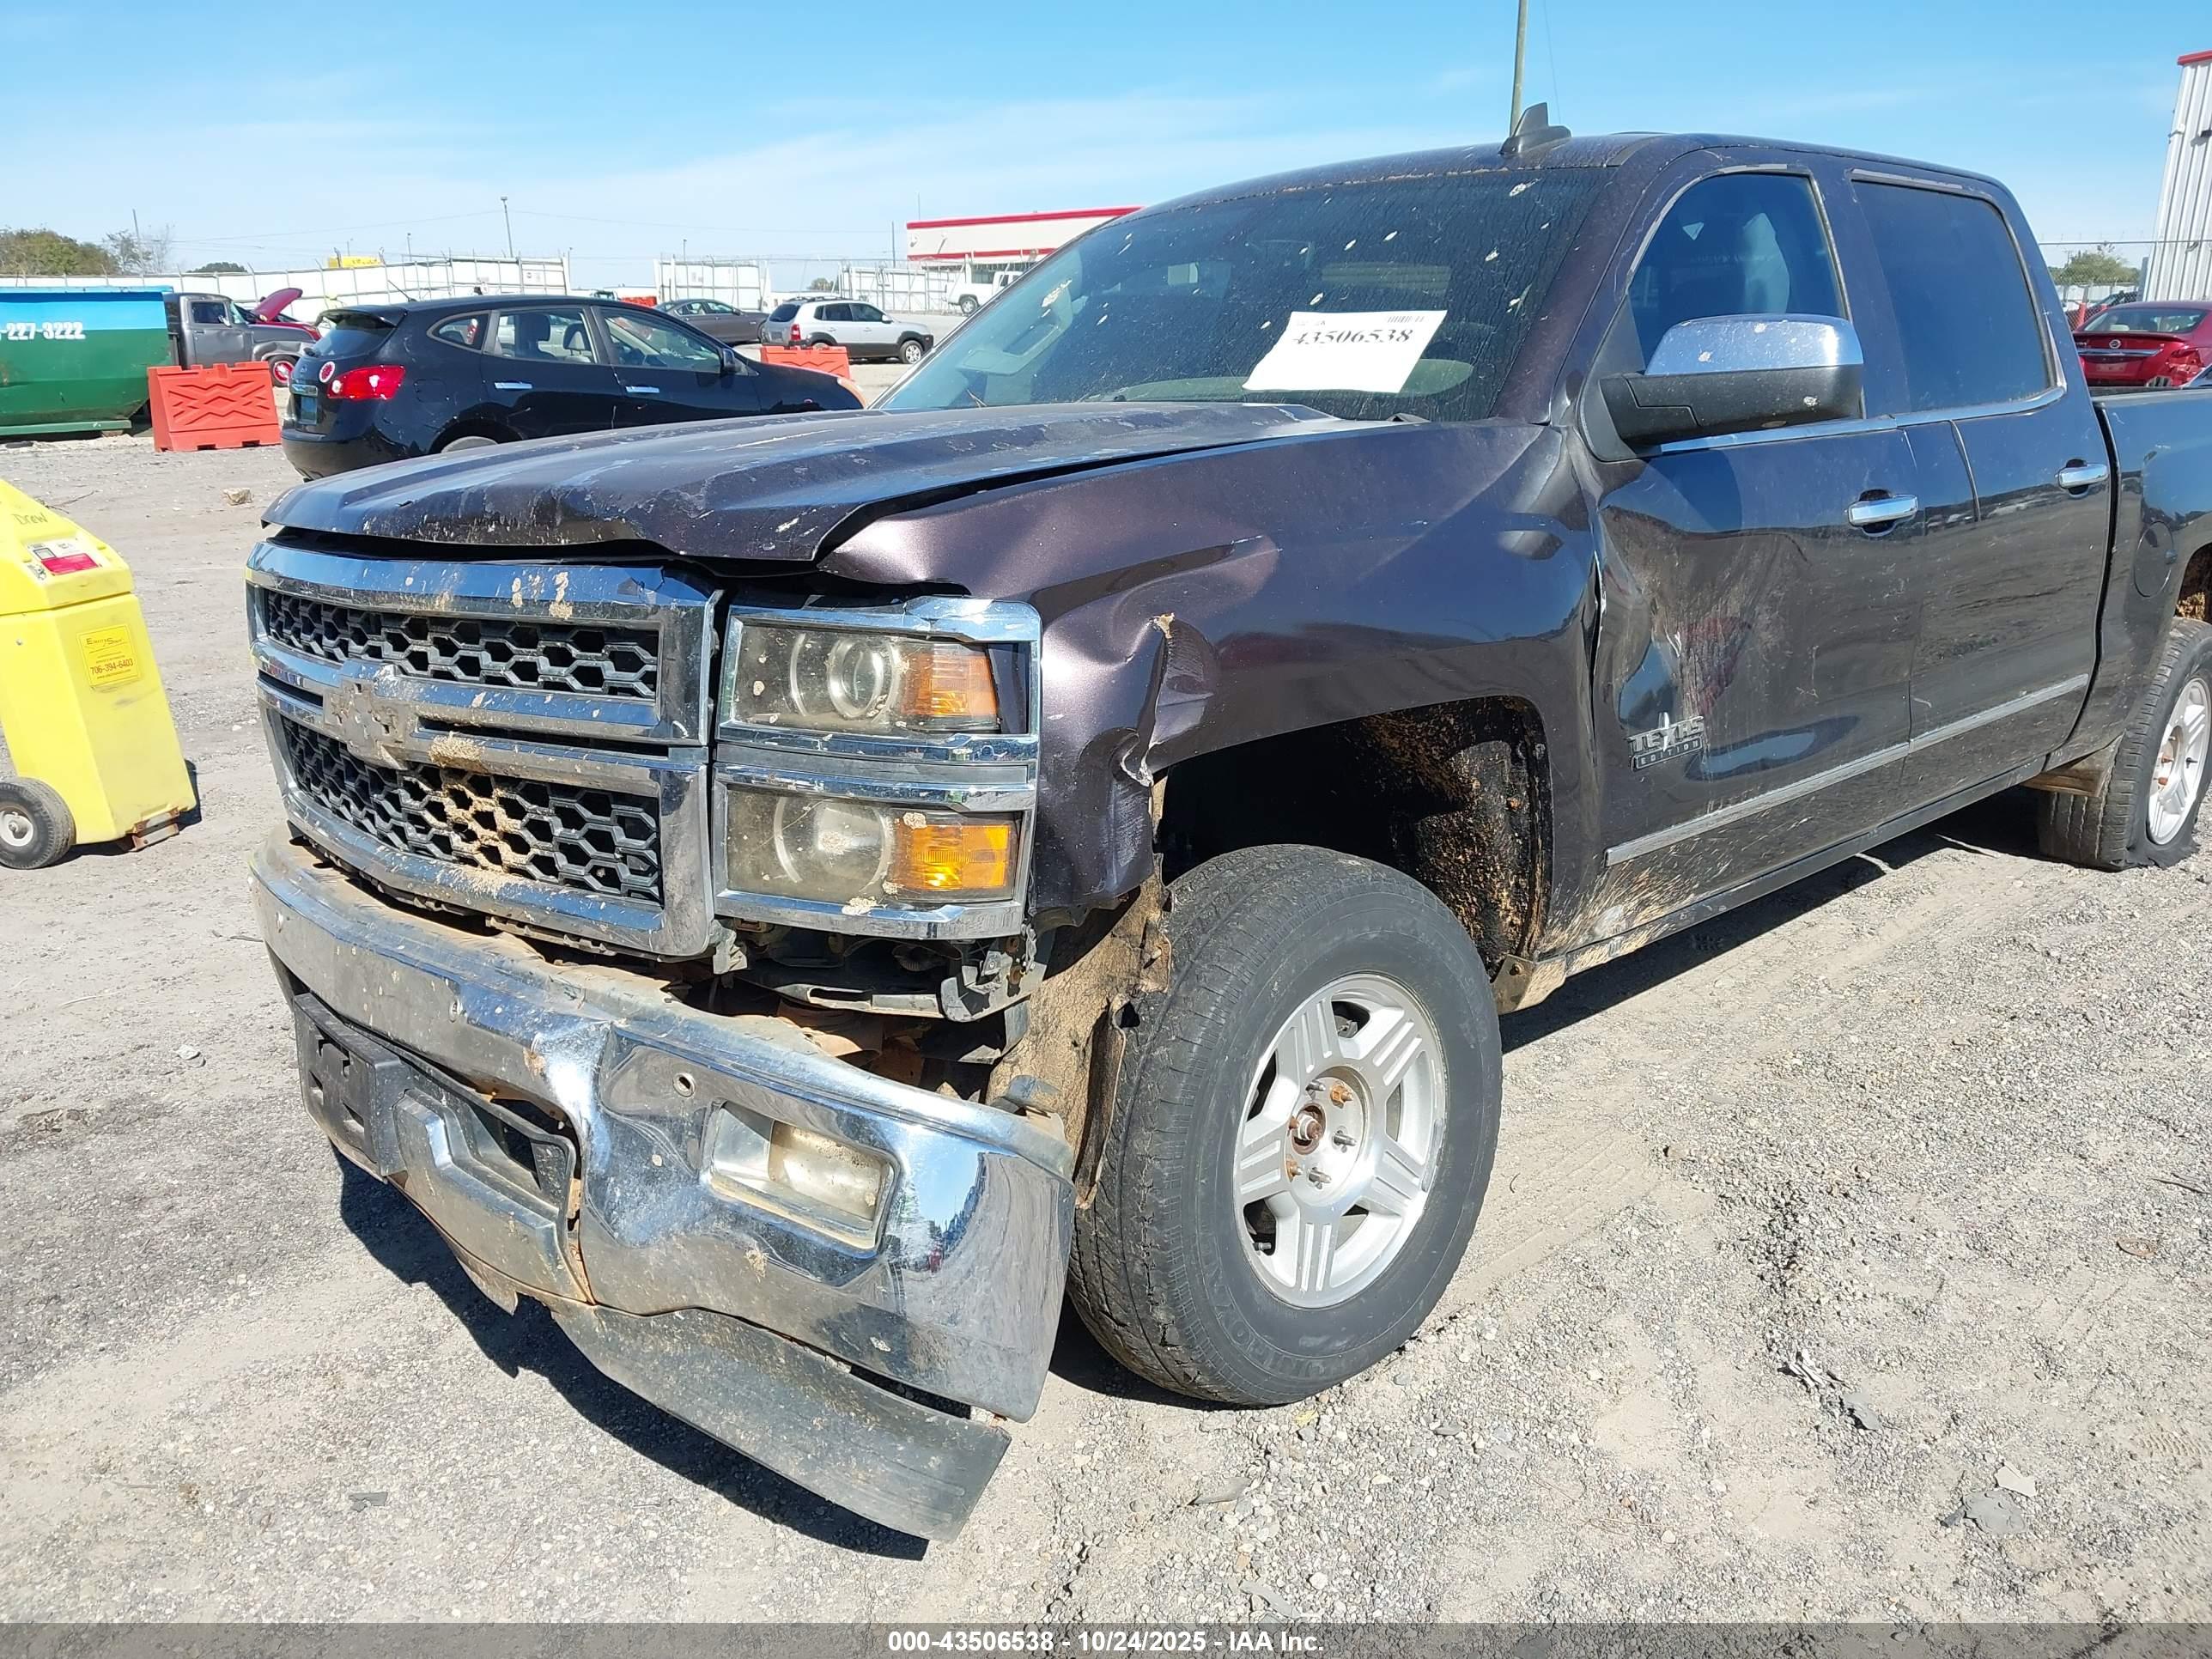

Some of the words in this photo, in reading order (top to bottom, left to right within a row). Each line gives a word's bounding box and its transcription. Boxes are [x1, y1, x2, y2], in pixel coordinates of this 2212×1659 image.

[0, 321, 86, 340] -227-3222
[1292, 329, 1413, 345] 43506538
[1627, 715, 1705, 752] TEXAS
[1640, 740, 1699, 765] EDITION
